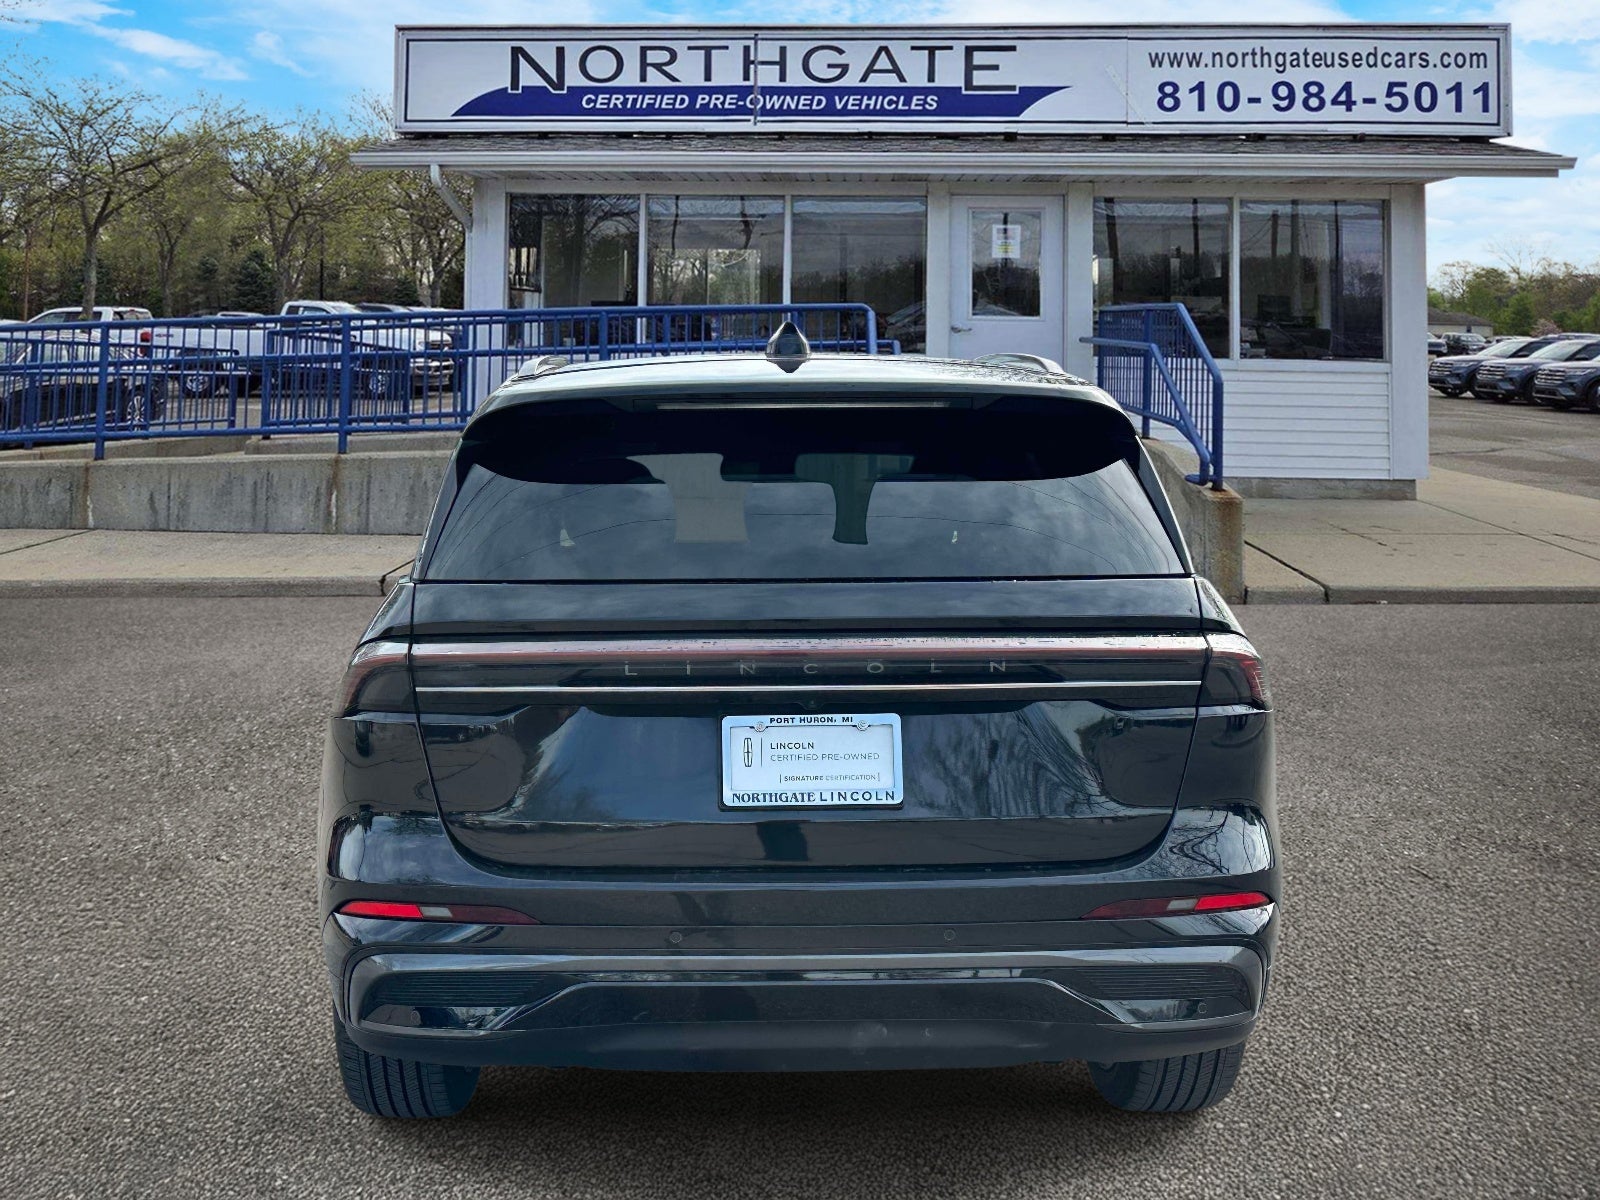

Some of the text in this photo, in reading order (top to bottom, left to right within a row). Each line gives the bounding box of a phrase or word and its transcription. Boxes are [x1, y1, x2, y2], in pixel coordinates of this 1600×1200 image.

[1149, 47, 1488, 73] www.northgateusedcars.com
[510, 45, 1017, 92] NORTHGATE
[581, 93, 939, 111] CERTIFIED PRE-OWNED VEHICLES
[1157, 80, 1491, 113] 810-984-5011
[624, 660, 1007, 676] LINCOLN
[770, 742, 815, 750] LINCOLN
[770, 753, 880, 762] CERTIFIED PRE-OWNED
[784, 774, 824, 782] SIGNATURE
[732, 791, 895, 803] NORTHGATE LINCOLN
